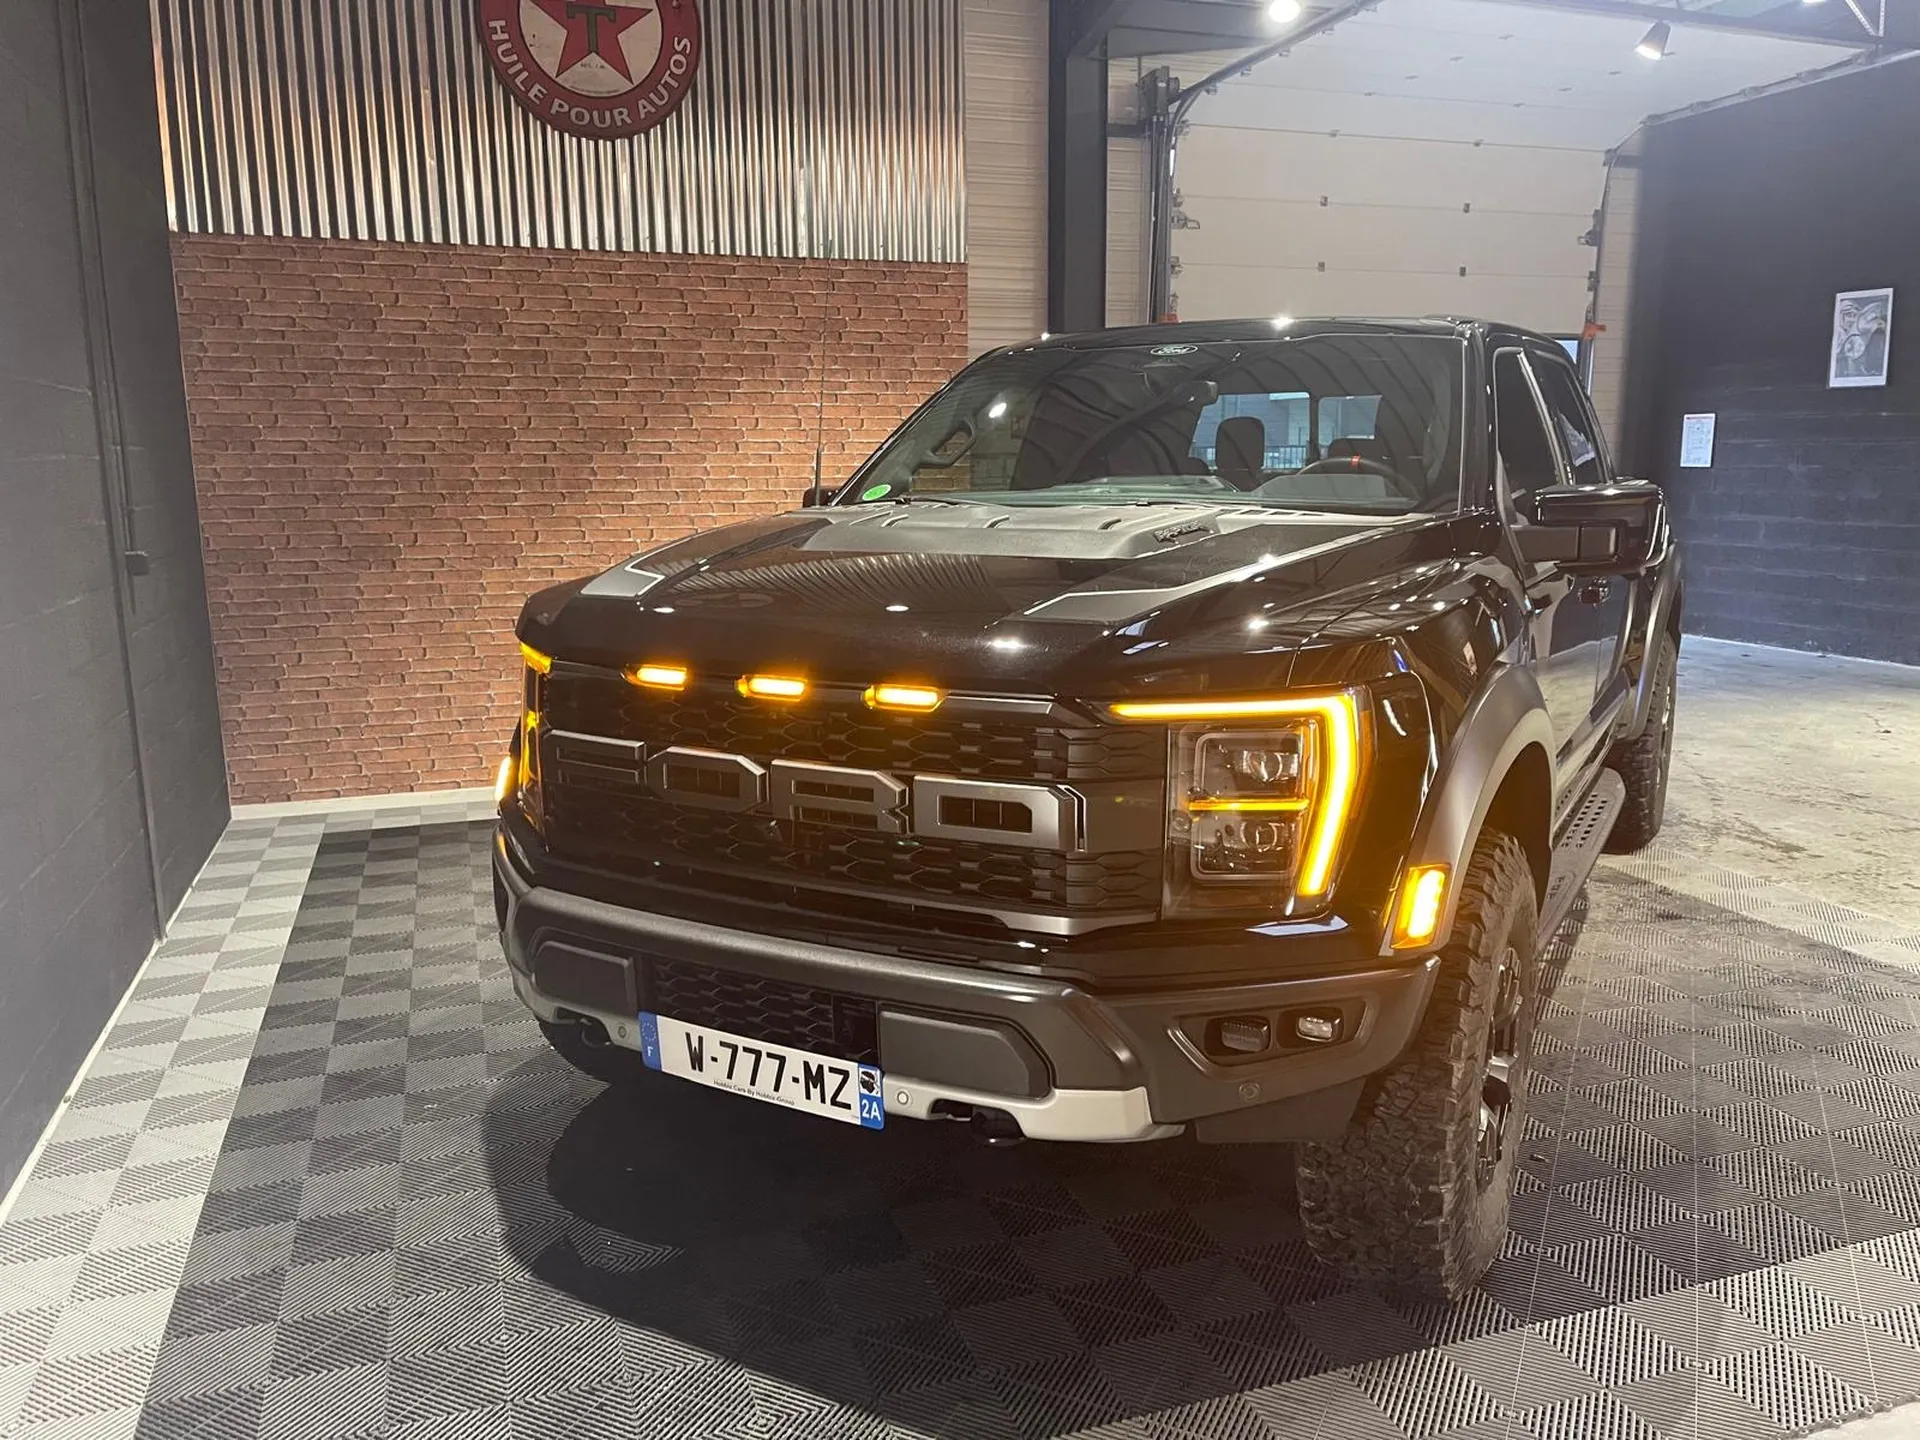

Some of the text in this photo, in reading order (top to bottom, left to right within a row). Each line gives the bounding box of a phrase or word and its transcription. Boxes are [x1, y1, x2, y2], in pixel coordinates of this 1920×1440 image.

[566, 2, 616, 52] T
[488, 19, 691, 128] HUILE POUR AUTOS
[541, 729, 1088, 852] FORD
[685, 1032, 852, 1110] W-777-MZ
[861, 1098, 881, 1121] 2A
